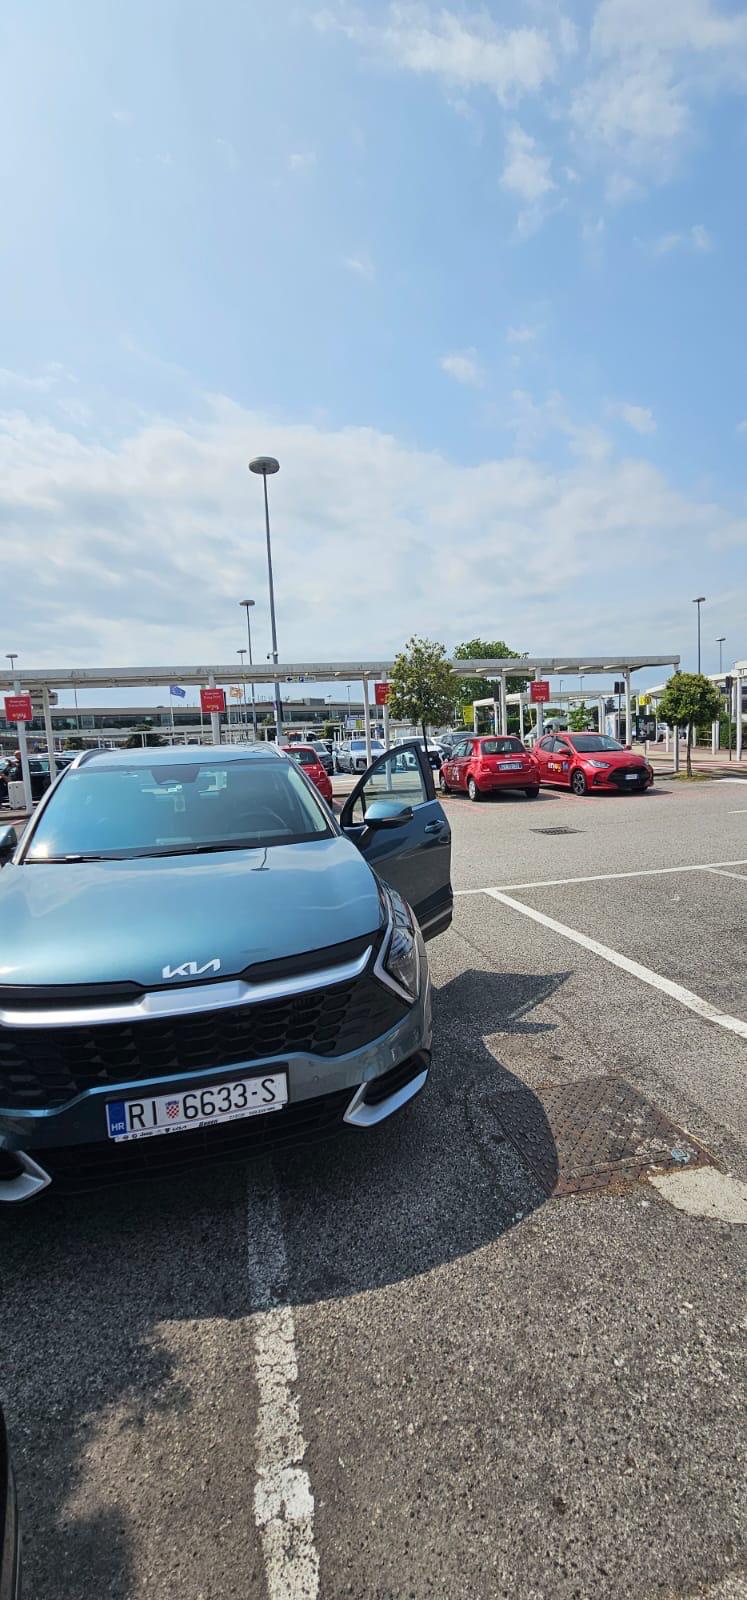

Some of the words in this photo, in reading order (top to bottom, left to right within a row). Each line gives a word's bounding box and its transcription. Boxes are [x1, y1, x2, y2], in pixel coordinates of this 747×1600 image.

[162, 958, 221, 979] KIA
[128, 1100, 158, 1130] RI
[182, 1077, 277, 1120] 6633-S
[111, 1122, 125, 1132] HR
